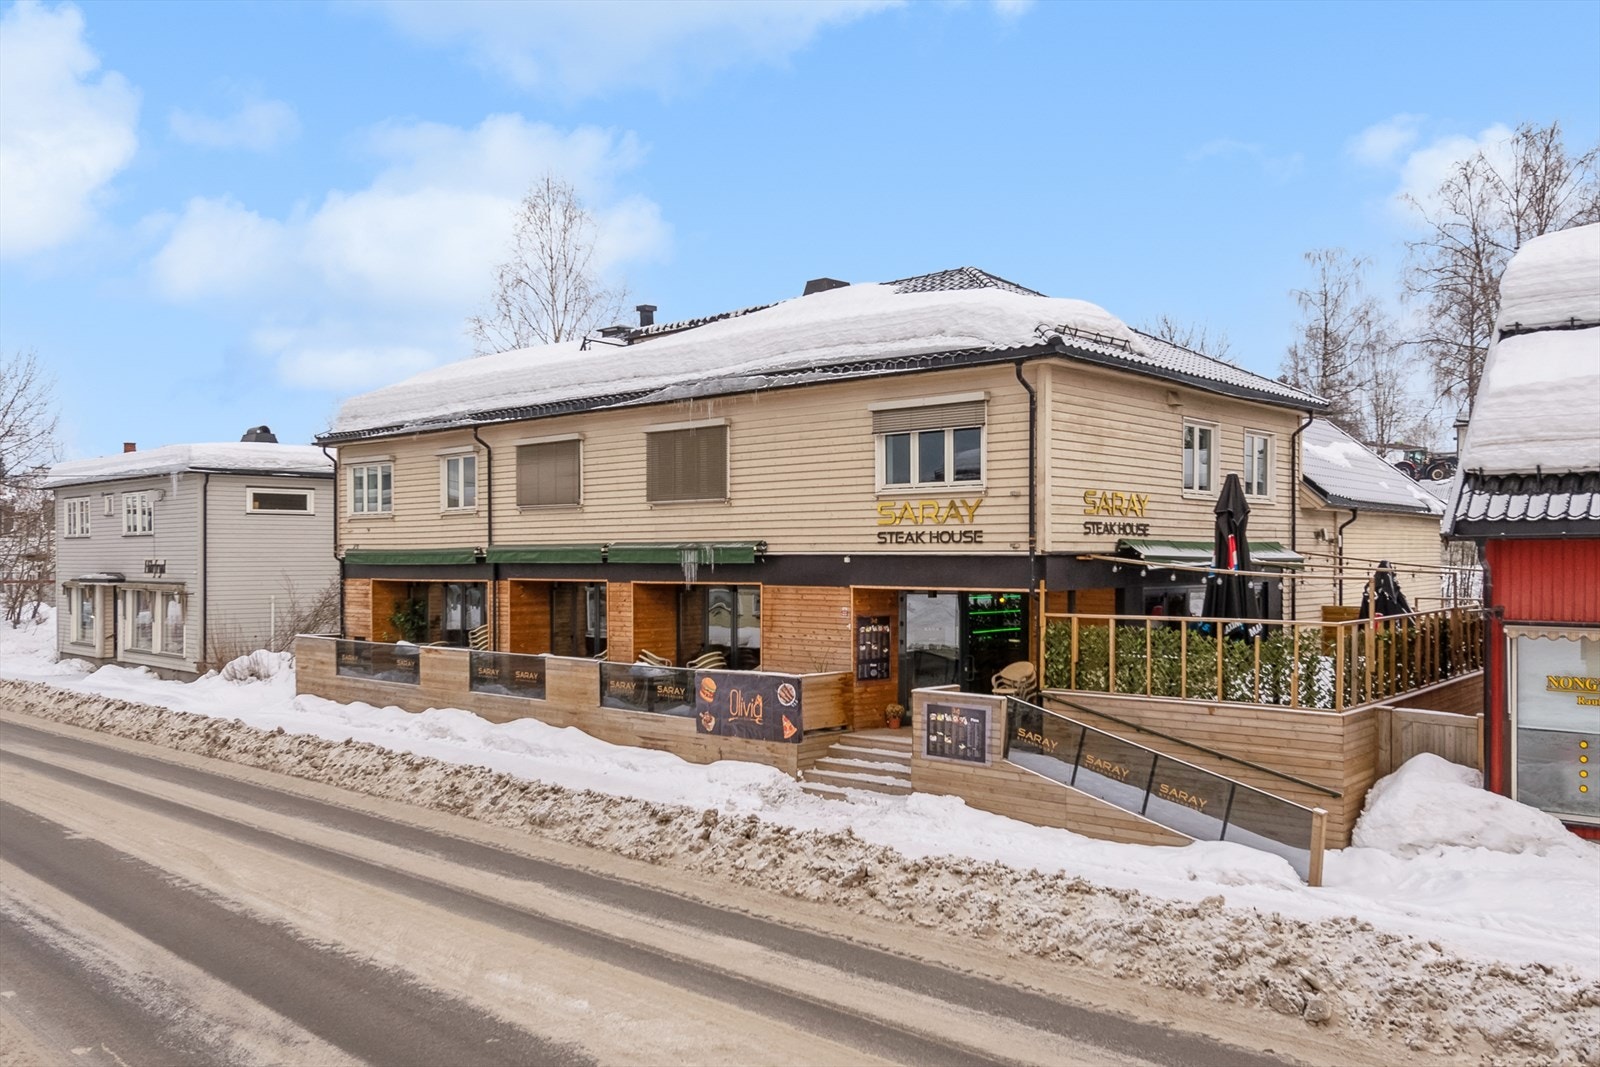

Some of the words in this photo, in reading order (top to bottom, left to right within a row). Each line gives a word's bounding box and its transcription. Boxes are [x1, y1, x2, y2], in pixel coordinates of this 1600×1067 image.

[877, 499, 983, 525] SARAY
[1083, 490, 1149, 517] SARAY
[877, 531, 925, 544] STEAK
[929, 530, 983, 544] HOUSE
[1083, 521, 1116, 535] STEAK
[1117, 522, 1150, 537] HOUSE
[478, 667, 499, 675] SARAY
[515, 670, 538, 679] SARAY
[610, 680, 636, 690] SARAY
[657, 685, 685, 695] SARAY
[729, 688, 763, 718] Olivia
[1018, 727, 1058, 749] SARAY
[1085, 754, 1129, 777] SARAY
[1160, 783, 1207, 808] SARAY
